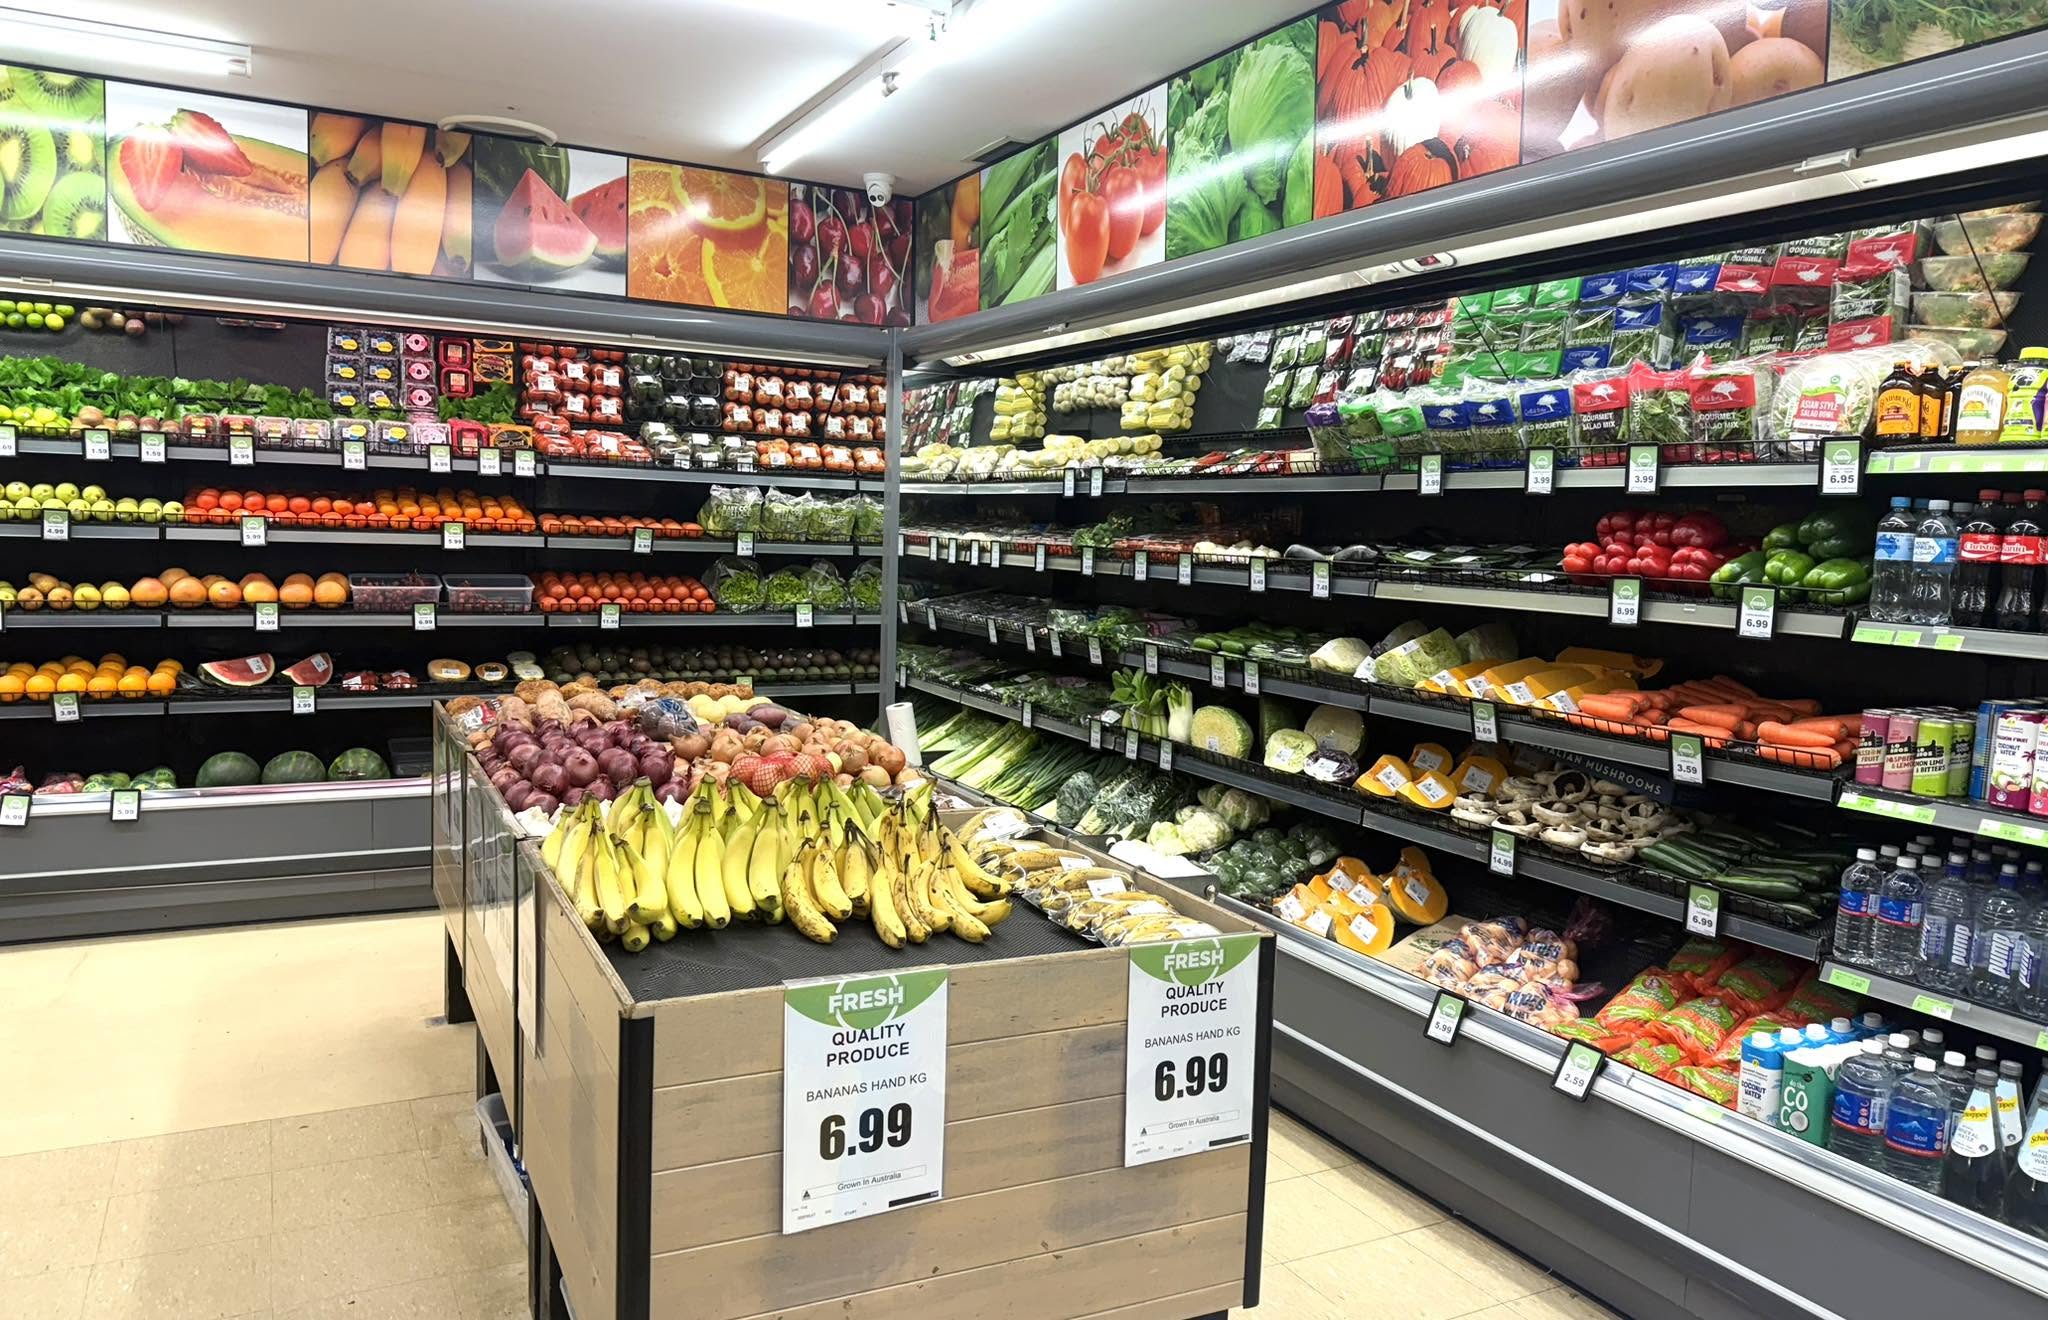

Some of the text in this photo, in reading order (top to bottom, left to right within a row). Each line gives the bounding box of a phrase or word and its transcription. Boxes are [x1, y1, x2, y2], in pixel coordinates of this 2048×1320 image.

[1582, 412, 1614, 422] GOURMET
[1699, 412, 1737, 423] GOURMET
[1603, 421, 1616, 429] MIX
[1425, 479, 1439, 487] 3.99
[1534, 477, 1550, 485] 3.99
[1634, 476, 1653, 485] 3.99
[1830, 475, 1854, 484] 6.95
[1616, 607, 1635, 616] 8.99
[1746, 618, 1768, 629] 6.99
[1475, 726, 1492, 735] 3.69
[1677, 763, 1697, 775] 3.59
[1919, 765, 1946, 774] BITTERS
[1585, 758, 1663, 796] MUSHROOMS
[1492, 855, 1513, 868] 14.99
[1692, 914, 1713, 928] 6.99
[1951, 924, 1972, 967] pump
[1164, 948, 1225, 971] FRESH
[1988, 932, 2015, 980] pump
[2019, 941, 2035, 989] pump
[1166, 981, 1225, 1000] QUALITY
[828, 985, 904, 1014] FRESH
[1161, 998, 1227, 1018] PRODUCE
[832, 1022, 905, 1046] QUALITY
[1434, 1020, 1453, 1034] 5.99
[1144, 1026, 1241, 1048] BANANAS HAND KG
[826, 1042, 910, 1067] PRODUCE
[1155, 1052, 1228, 1102] 6.99
[1563, 1072, 1585, 1087] 2.59
[806, 1072, 927, 1102] BANANAS HAND KG
[1741, 1080, 1767, 1095] COCONUT
[1744, 1088, 1762, 1101] WATER
[1783, 1086, 1809, 1112] CO
[1168, 1120, 1187, 1130] Grown
[1195, 1115, 1220, 1125] Australia
[819, 1102, 913, 1161] 6.99
[837, 1181, 861, 1191] Grown
[871, 1171, 902, 1184] Australia
